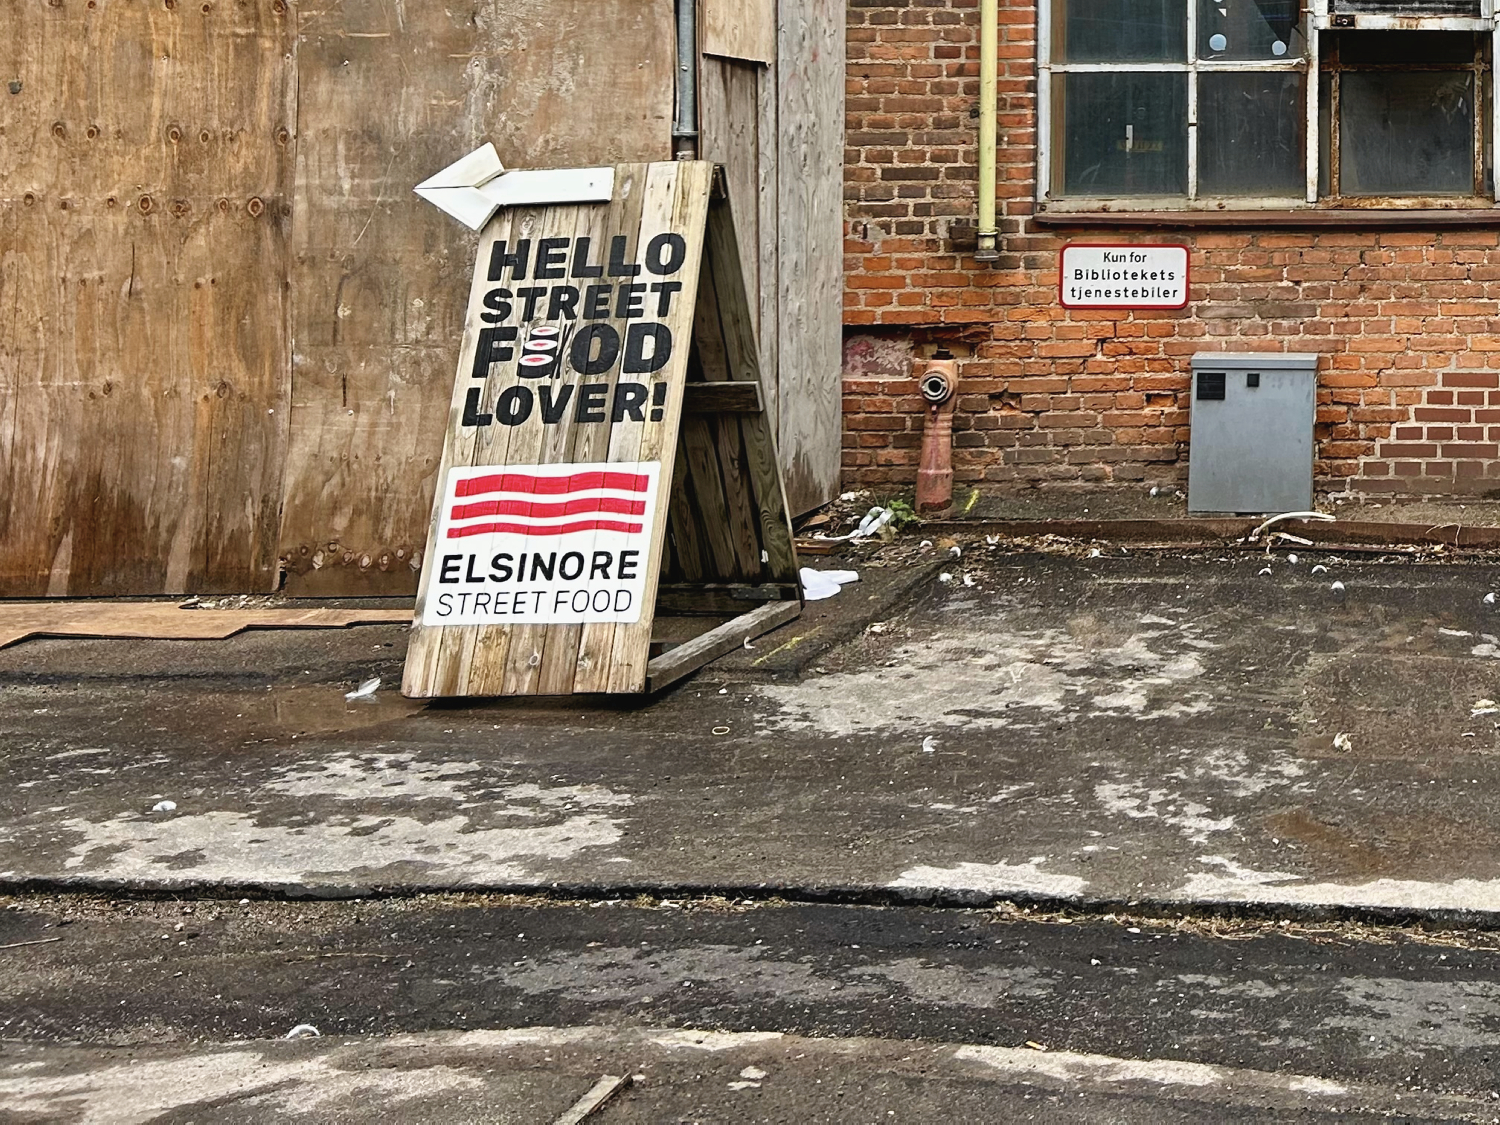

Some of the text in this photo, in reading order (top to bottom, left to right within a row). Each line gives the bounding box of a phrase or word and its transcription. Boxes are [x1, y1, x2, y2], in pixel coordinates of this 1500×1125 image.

[487, 232, 686, 281] HELLO
[1103, 252, 1147, 263] Kun for
[1074, 269, 1175, 281] Bibliotekets
[480, 282, 682, 323] STREET
[1070, 286, 1178, 300] tjenestebiler
[462, 382, 667, 427] LOVER!
[438, 550, 640, 584] ELSINORE
[436, 588, 633, 616] STREET FOOD
